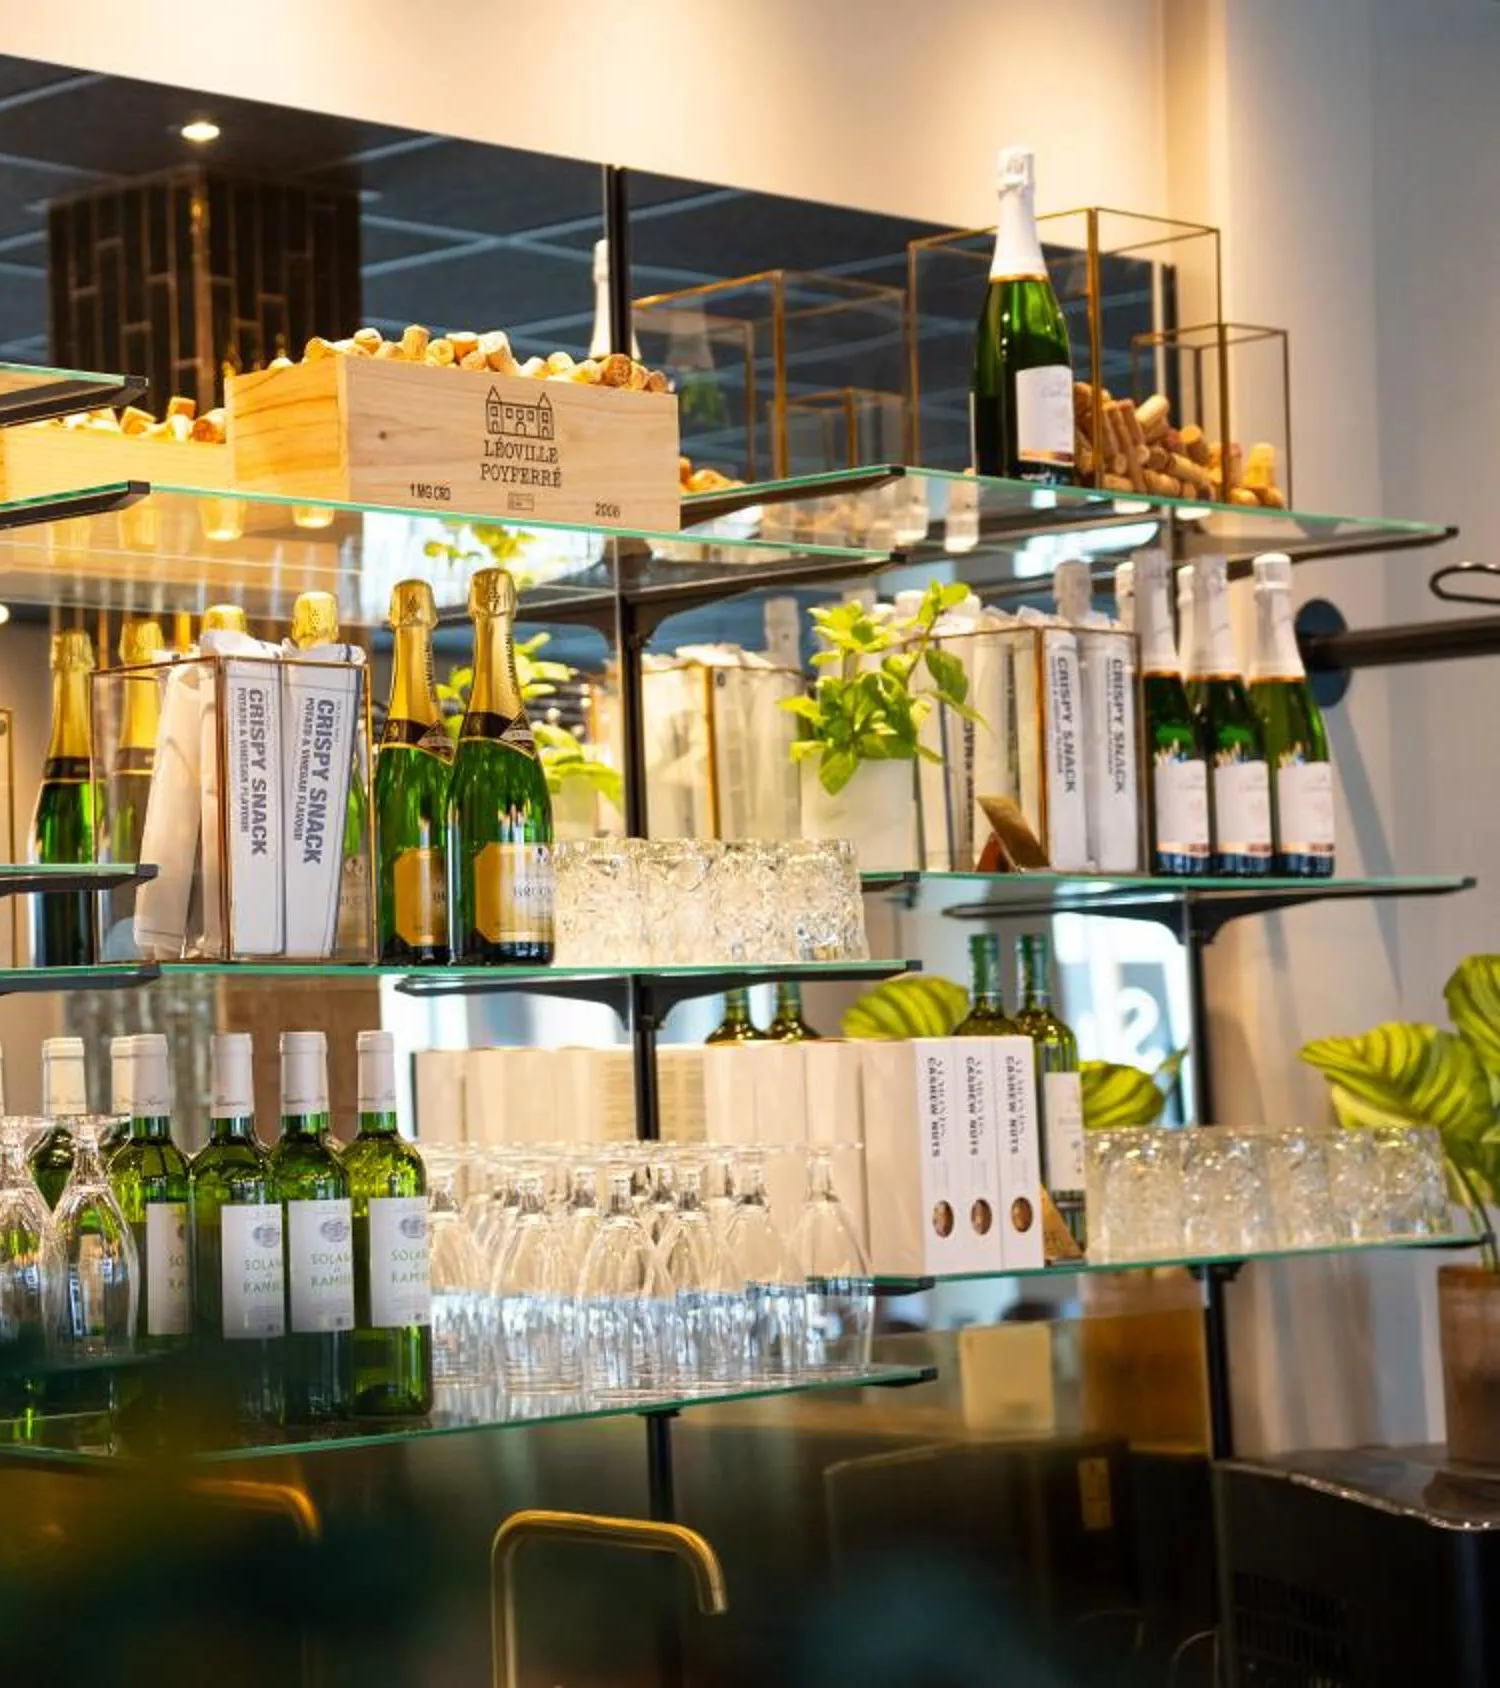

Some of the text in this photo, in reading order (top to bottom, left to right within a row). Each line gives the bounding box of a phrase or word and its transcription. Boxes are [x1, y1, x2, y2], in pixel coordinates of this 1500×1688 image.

[480, 463, 562, 488] POYFERRÉ
[484, 439, 558, 463] LÉOVILLE
[303, 697, 315, 735] POTATO
[1057, 657, 1073, 723] CRISPY
[1111, 658, 1126, 794] CRISPY SNACK
[250, 688, 268, 856] CRISPY SNACK
[296, 748, 311, 793] VINEGAR
[303, 699, 335, 864] CRISPY SNACK
[1063, 730, 1077, 793] SNACK
